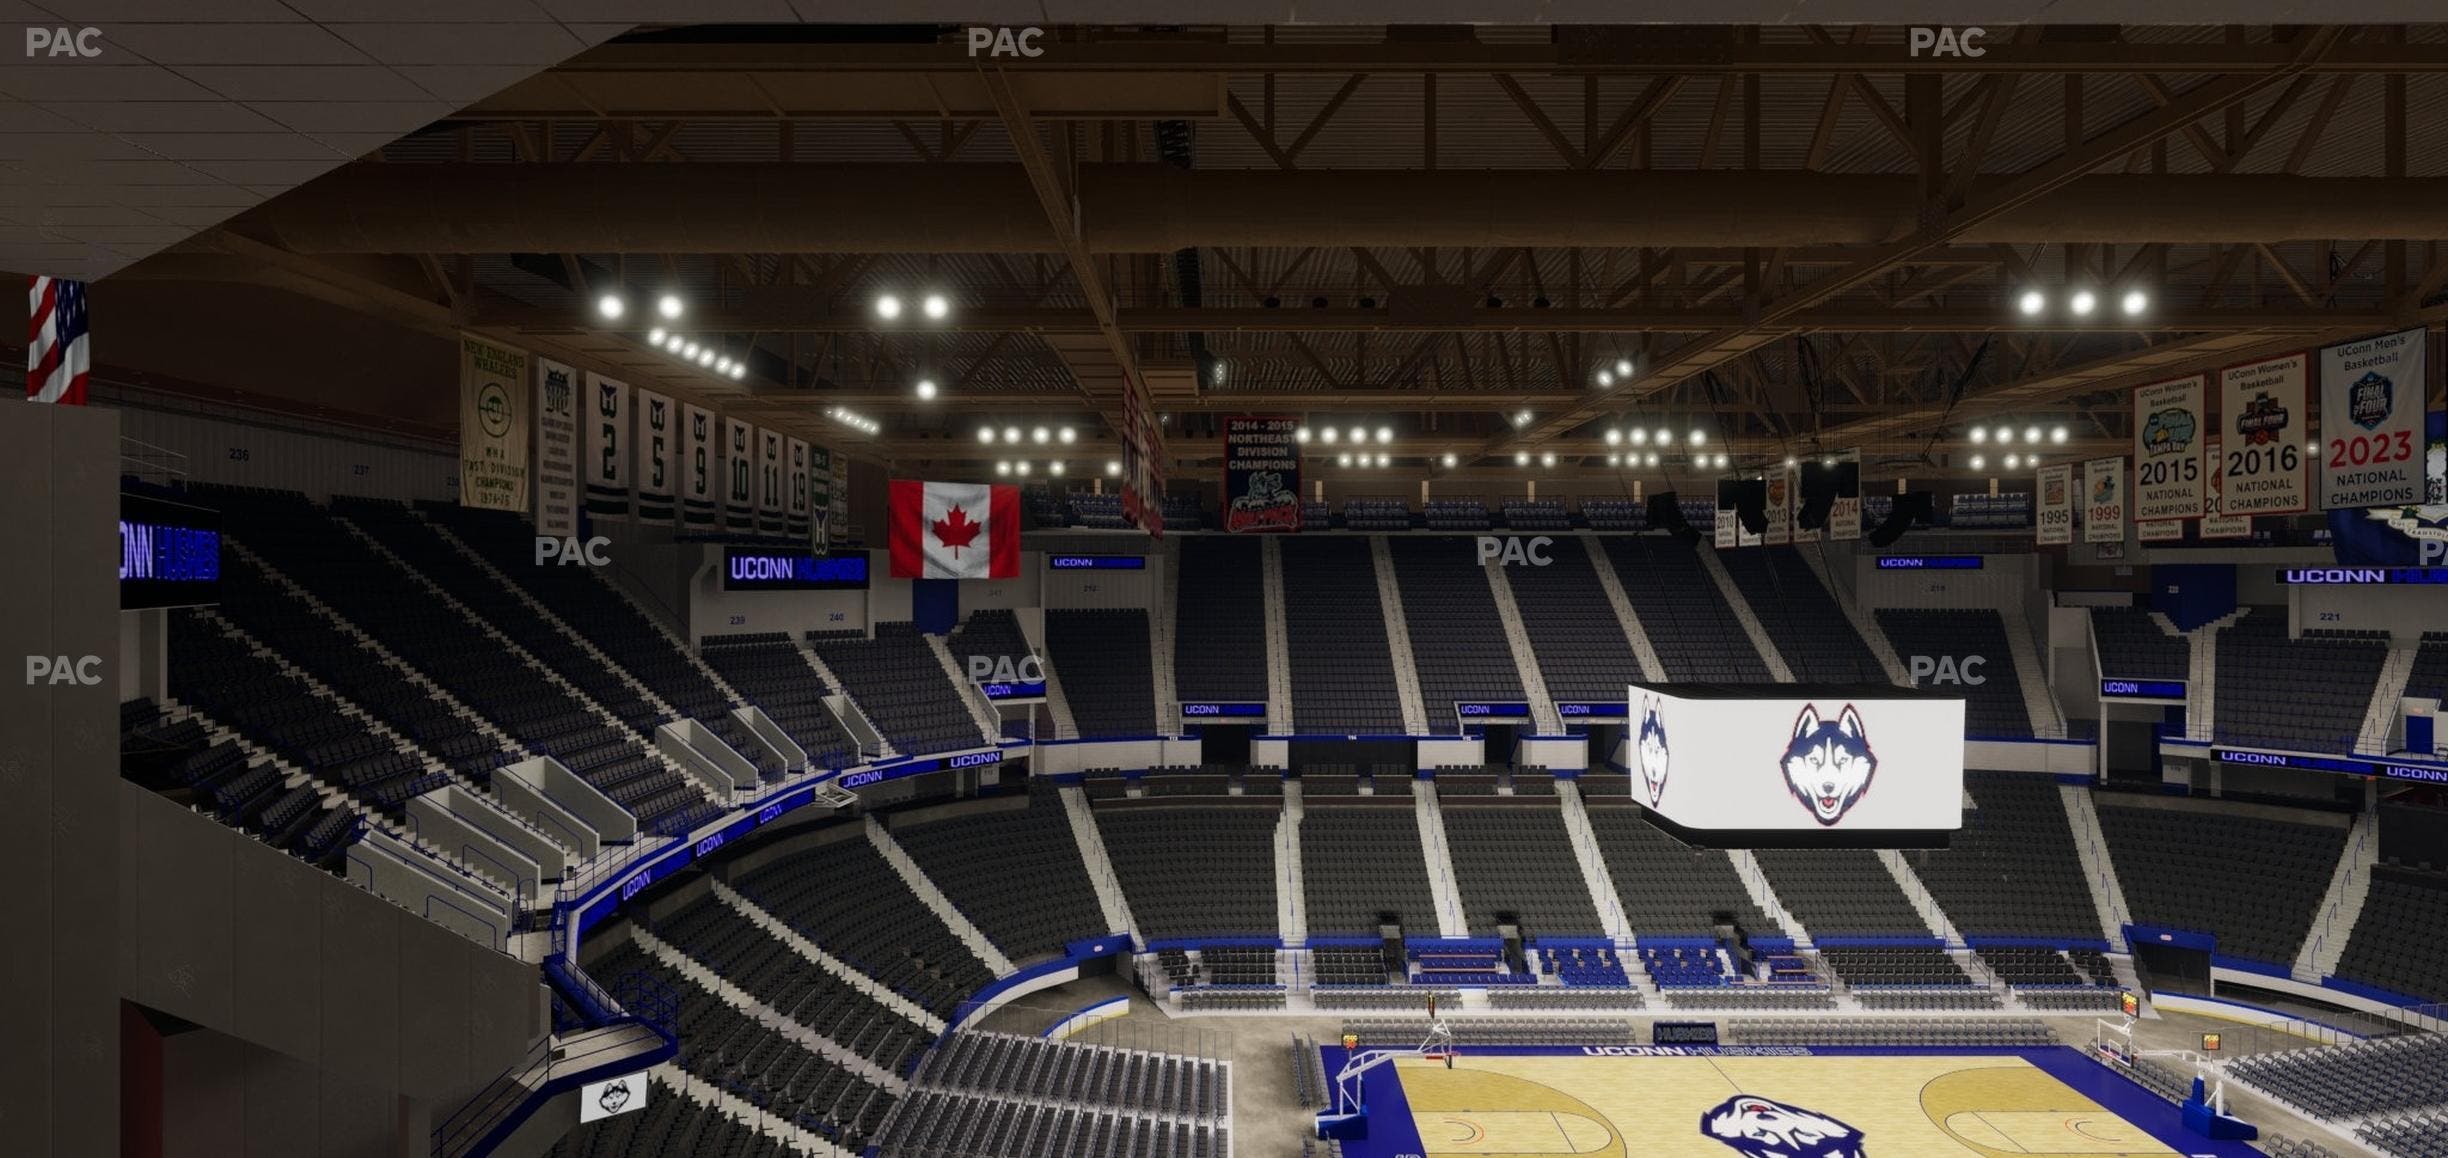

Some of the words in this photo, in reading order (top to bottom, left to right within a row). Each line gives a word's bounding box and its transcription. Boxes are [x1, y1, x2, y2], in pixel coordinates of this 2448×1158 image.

[2344, 352, 2398, 372] Basketball
[1231, 420, 1258, 432] 2014
[1267, 420, 1294, 431] 2015
[1228, 434, 1297, 445] NORTHEAST
[229, 448, 250, 462] 236
[602, 424, 616, 480] 2
[1237, 446, 1288, 457] DIVISION
[2329, 430, 2412, 468] 2023
[652, 436, 664, 488] 5
[1228, 460, 1297, 471] CHAMPIONS
[2228, 444, 2298, 477] 2016
[696, 446, 706, 495] 9
[2140, 457, 2198, 486] 2015
[2336, 470, 2406, 486] NATIONAL
[732, 456, 750, 502] 10
[764, 464, 778, 507] 11
[2236, 478, 2292, 493] NATIONAL
[2146, 488, 2193, 501] NATIONAL
[2331, 486, 2413, 505] CHAMPIONS
[1832, 501, 1858, 517] 2014
[2141, 503, 2198, 516] CHAMPIONS
[2230, 495, 2298, 510] CHAMPIONS
[2041, 510, 2069, 525] 1995
[2088, 505, 2120, 521] 1999
[732, 556, 793, 580] UCONN
[1054, 558, 1093, 568] UCONN
[1880, 558, 1923, 568] UCONN
[2288, 569, 2385, 583] UCONN
[2319, 612, 2341, 622] 221
[2104, 682, 2138, 694] UCONN
[1185, 704, 1220, 714] UCONN
[1460, 704, 1490, 714] UCONN
[1561, 704, 1590, 714] UCONN
[950, 752, 1000, 768] UCONN
[2220, 750, 2286, 766] UCONN
[2386, 766, 2448, 782] UCONN
[622, 870, 651, 902] UCONN
[1656, 1026, 1716, 1042] HUSKIES
[1582, 1046, 1687, 1056] UCONN
[1684, 1046, 1814, 1056] HUSKIES
